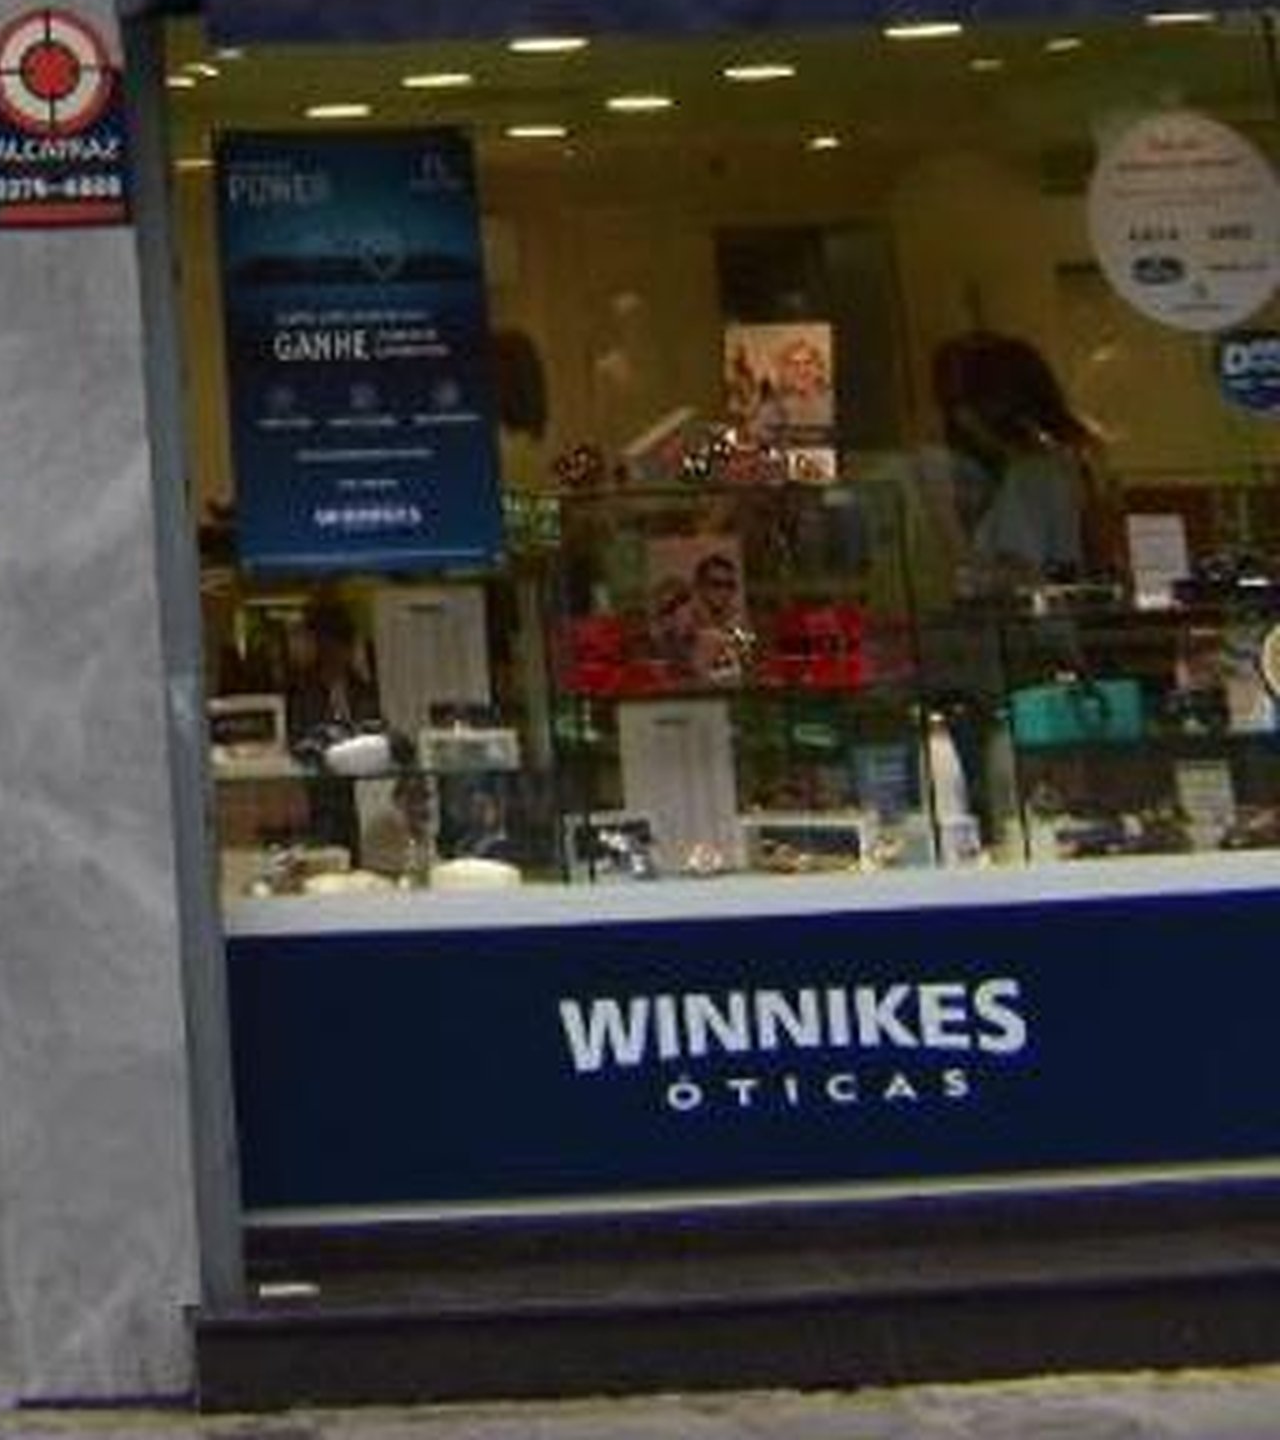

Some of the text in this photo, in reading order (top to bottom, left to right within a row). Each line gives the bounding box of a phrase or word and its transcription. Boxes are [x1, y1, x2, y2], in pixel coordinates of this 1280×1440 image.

[273, 329, 371, 362] GANHE
[558, 978, 1028, 1073] WINNIKES
[666, 1067, 971, 1111] ÓTICAS
